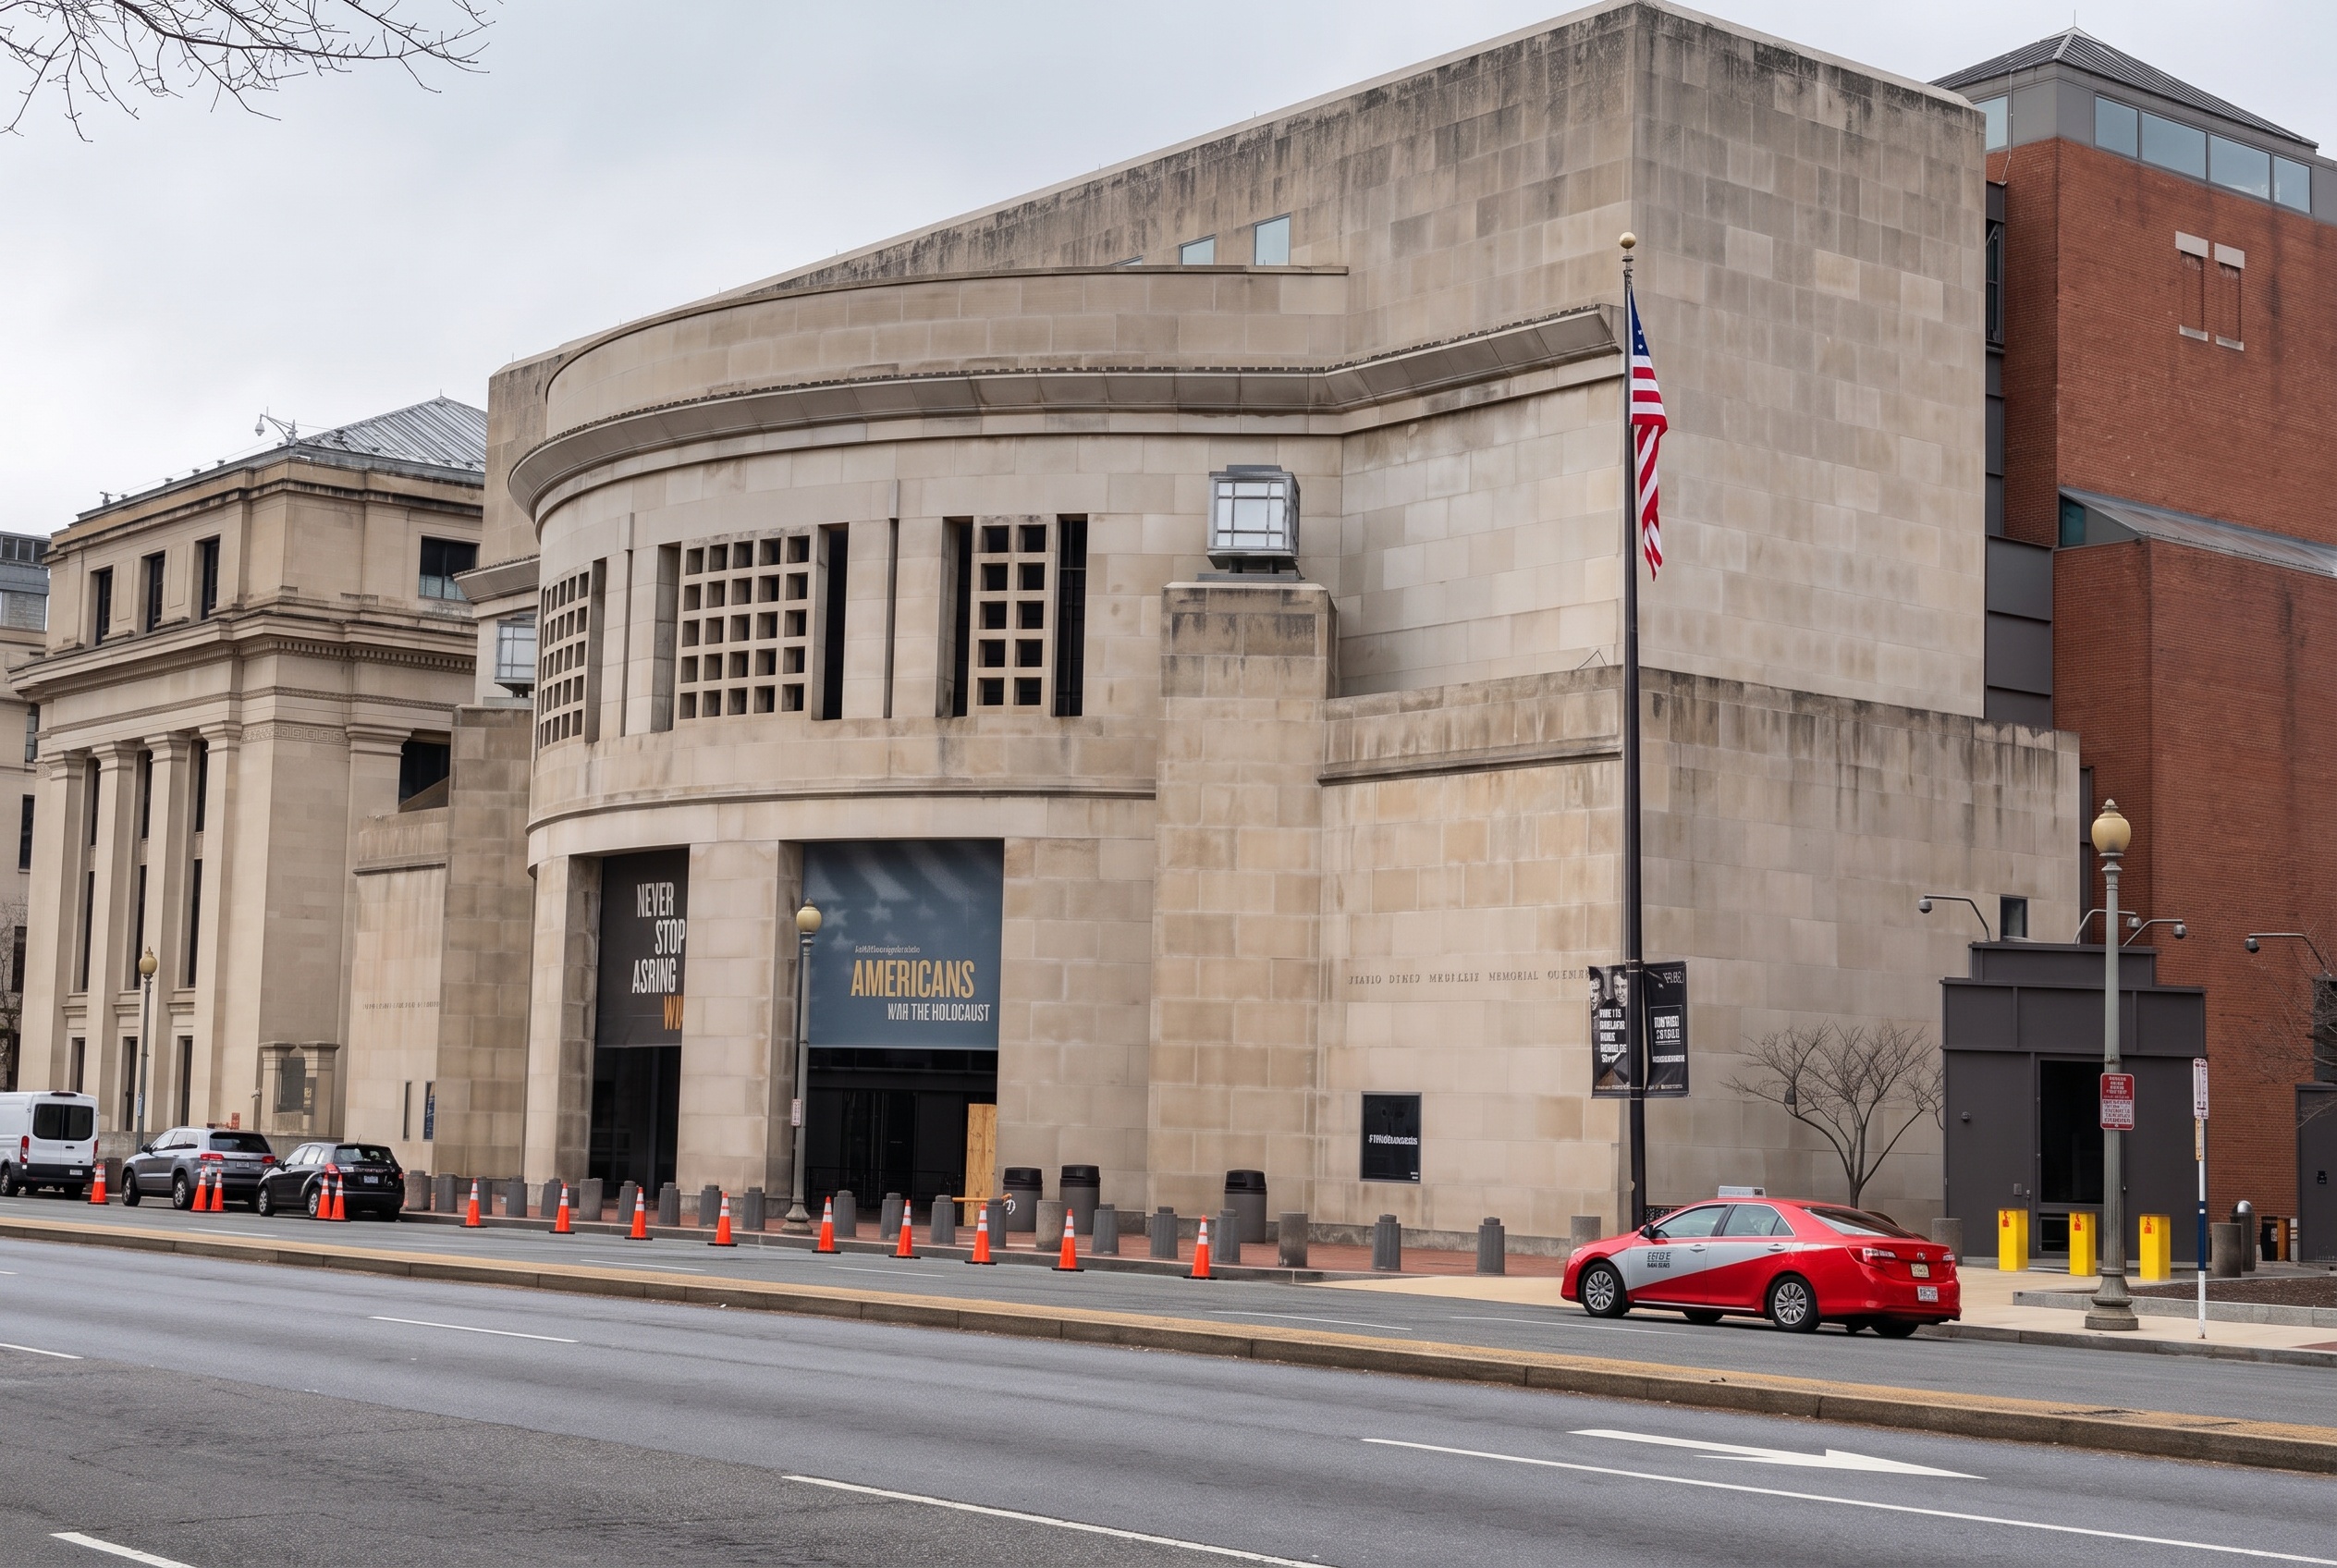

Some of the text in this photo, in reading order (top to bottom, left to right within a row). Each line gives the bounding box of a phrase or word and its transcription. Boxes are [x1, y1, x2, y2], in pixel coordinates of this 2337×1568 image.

[637, 882, 675, 917] NEVER
[655, 918, 686, 955] STOP
[850, 960, 975, 998] AMERICANS
[1488, 971, 1539, 982] MEMORIAL
[911, 1003, 930, 1021] THE
[932, 1003, 991, 1022] HOLOCAUST
